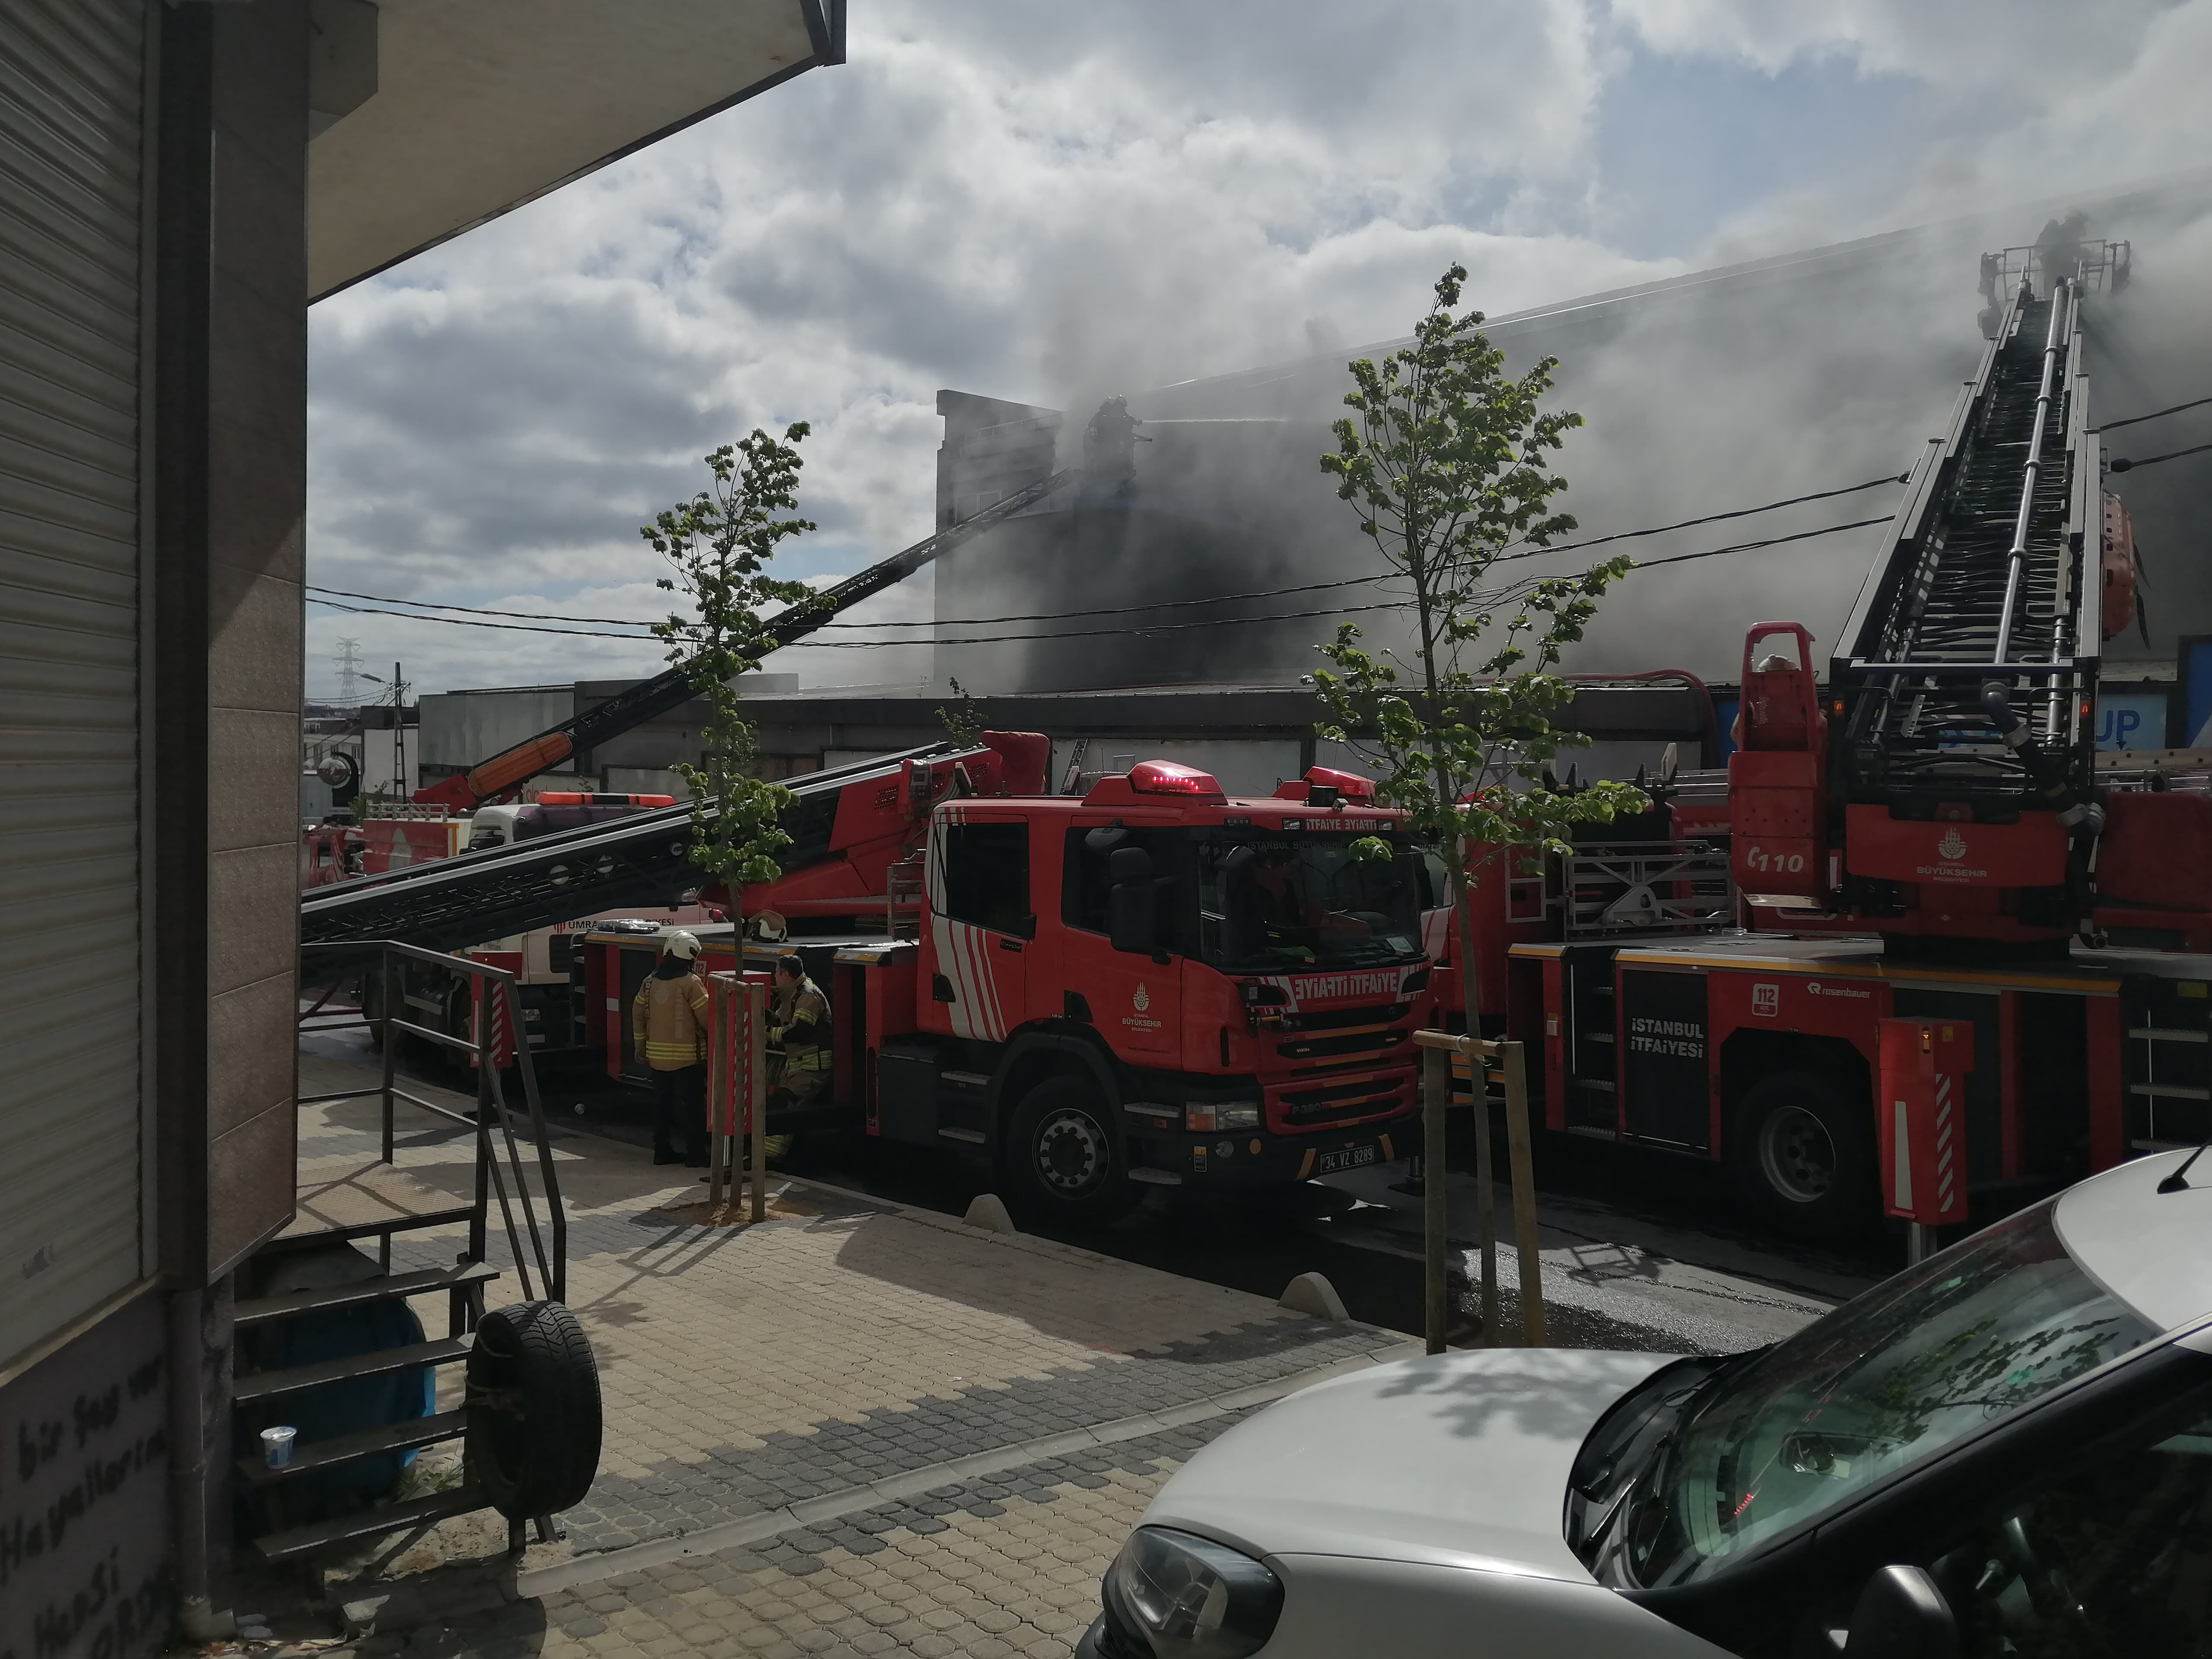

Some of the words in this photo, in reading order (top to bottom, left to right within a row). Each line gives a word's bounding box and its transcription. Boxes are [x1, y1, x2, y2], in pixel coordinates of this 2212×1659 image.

[1757, 854, 1804, 873] 110
[1757, 988, 1775, 1003] 112
[1631, 1017, 1704, 1039] İSTANBUL
[1630, 1036, 1703, 1058] İTFAİYESİ
[1325, 1155, 1335, 1170] 34
[1340, 1151, 1350, 1166] VZ
[1354, 1147, 1373, 1163] 8289
